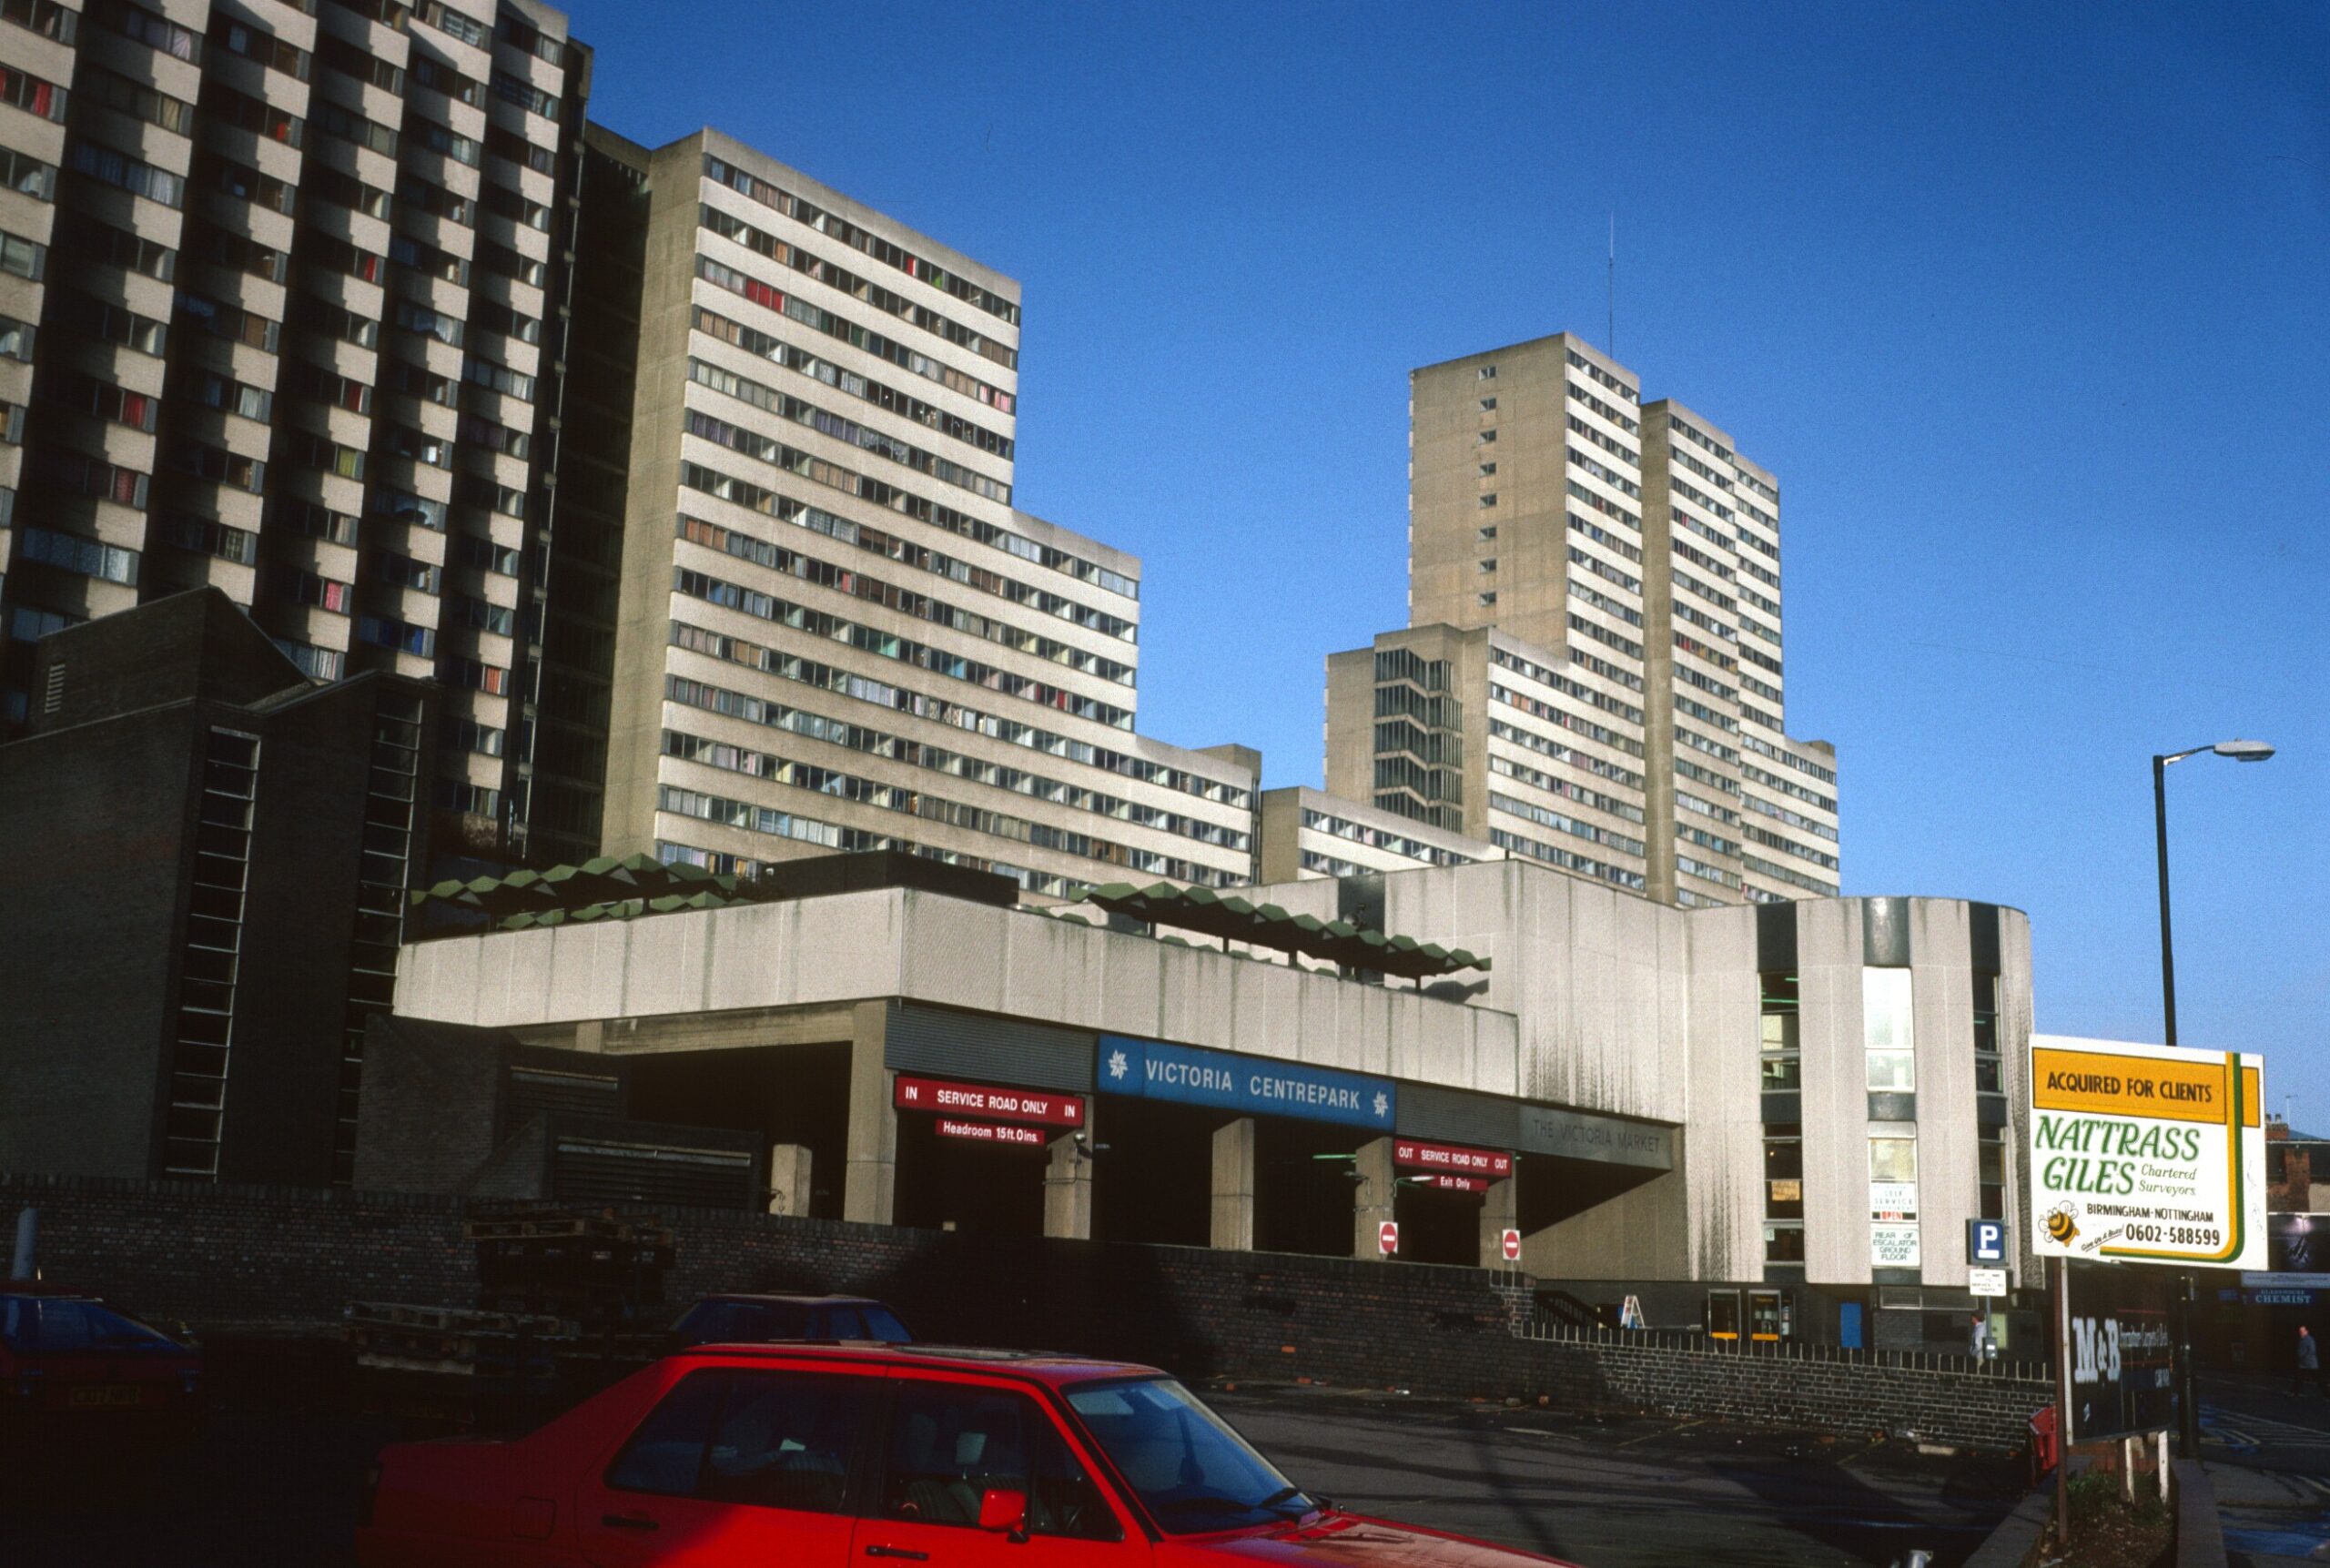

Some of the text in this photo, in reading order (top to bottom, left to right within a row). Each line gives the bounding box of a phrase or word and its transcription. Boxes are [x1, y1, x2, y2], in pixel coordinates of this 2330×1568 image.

[1145, 1058, 1360, 1110] VICTORIA CENTREPARK
[2048, 1072, 2213, 1103] ACQUIRED FOR CLIENTS
[905, 1086, 1076, 1118] IN SERVICE ROAD ONLY IN
[943, 1121, 992, 1138] Headroom
[1534, 1119, 1659, 1153] THE VICTORIA MARKET
[2034, 1115, 2201, 1161] NATTRASS
[1398, 1147, 1507, 1169] OUT SERVICE ROAD ONLY OUT
[1440, 1176, 1471, 1190] Exit Only
[2043, 1156, 2136, 1196] GILES
[2142, 1163, 2197, 1180] Chartered
[2139, 1179, 2196, 1198] Surveyors
[1881, 1211, 1902, 1220] OPEN
[1980, 1225, 1998, 1249] P
[2126, 1223, 2220, 1246] 0602-588599
[2255, 1295, 2312, 1304] CHEMIST
